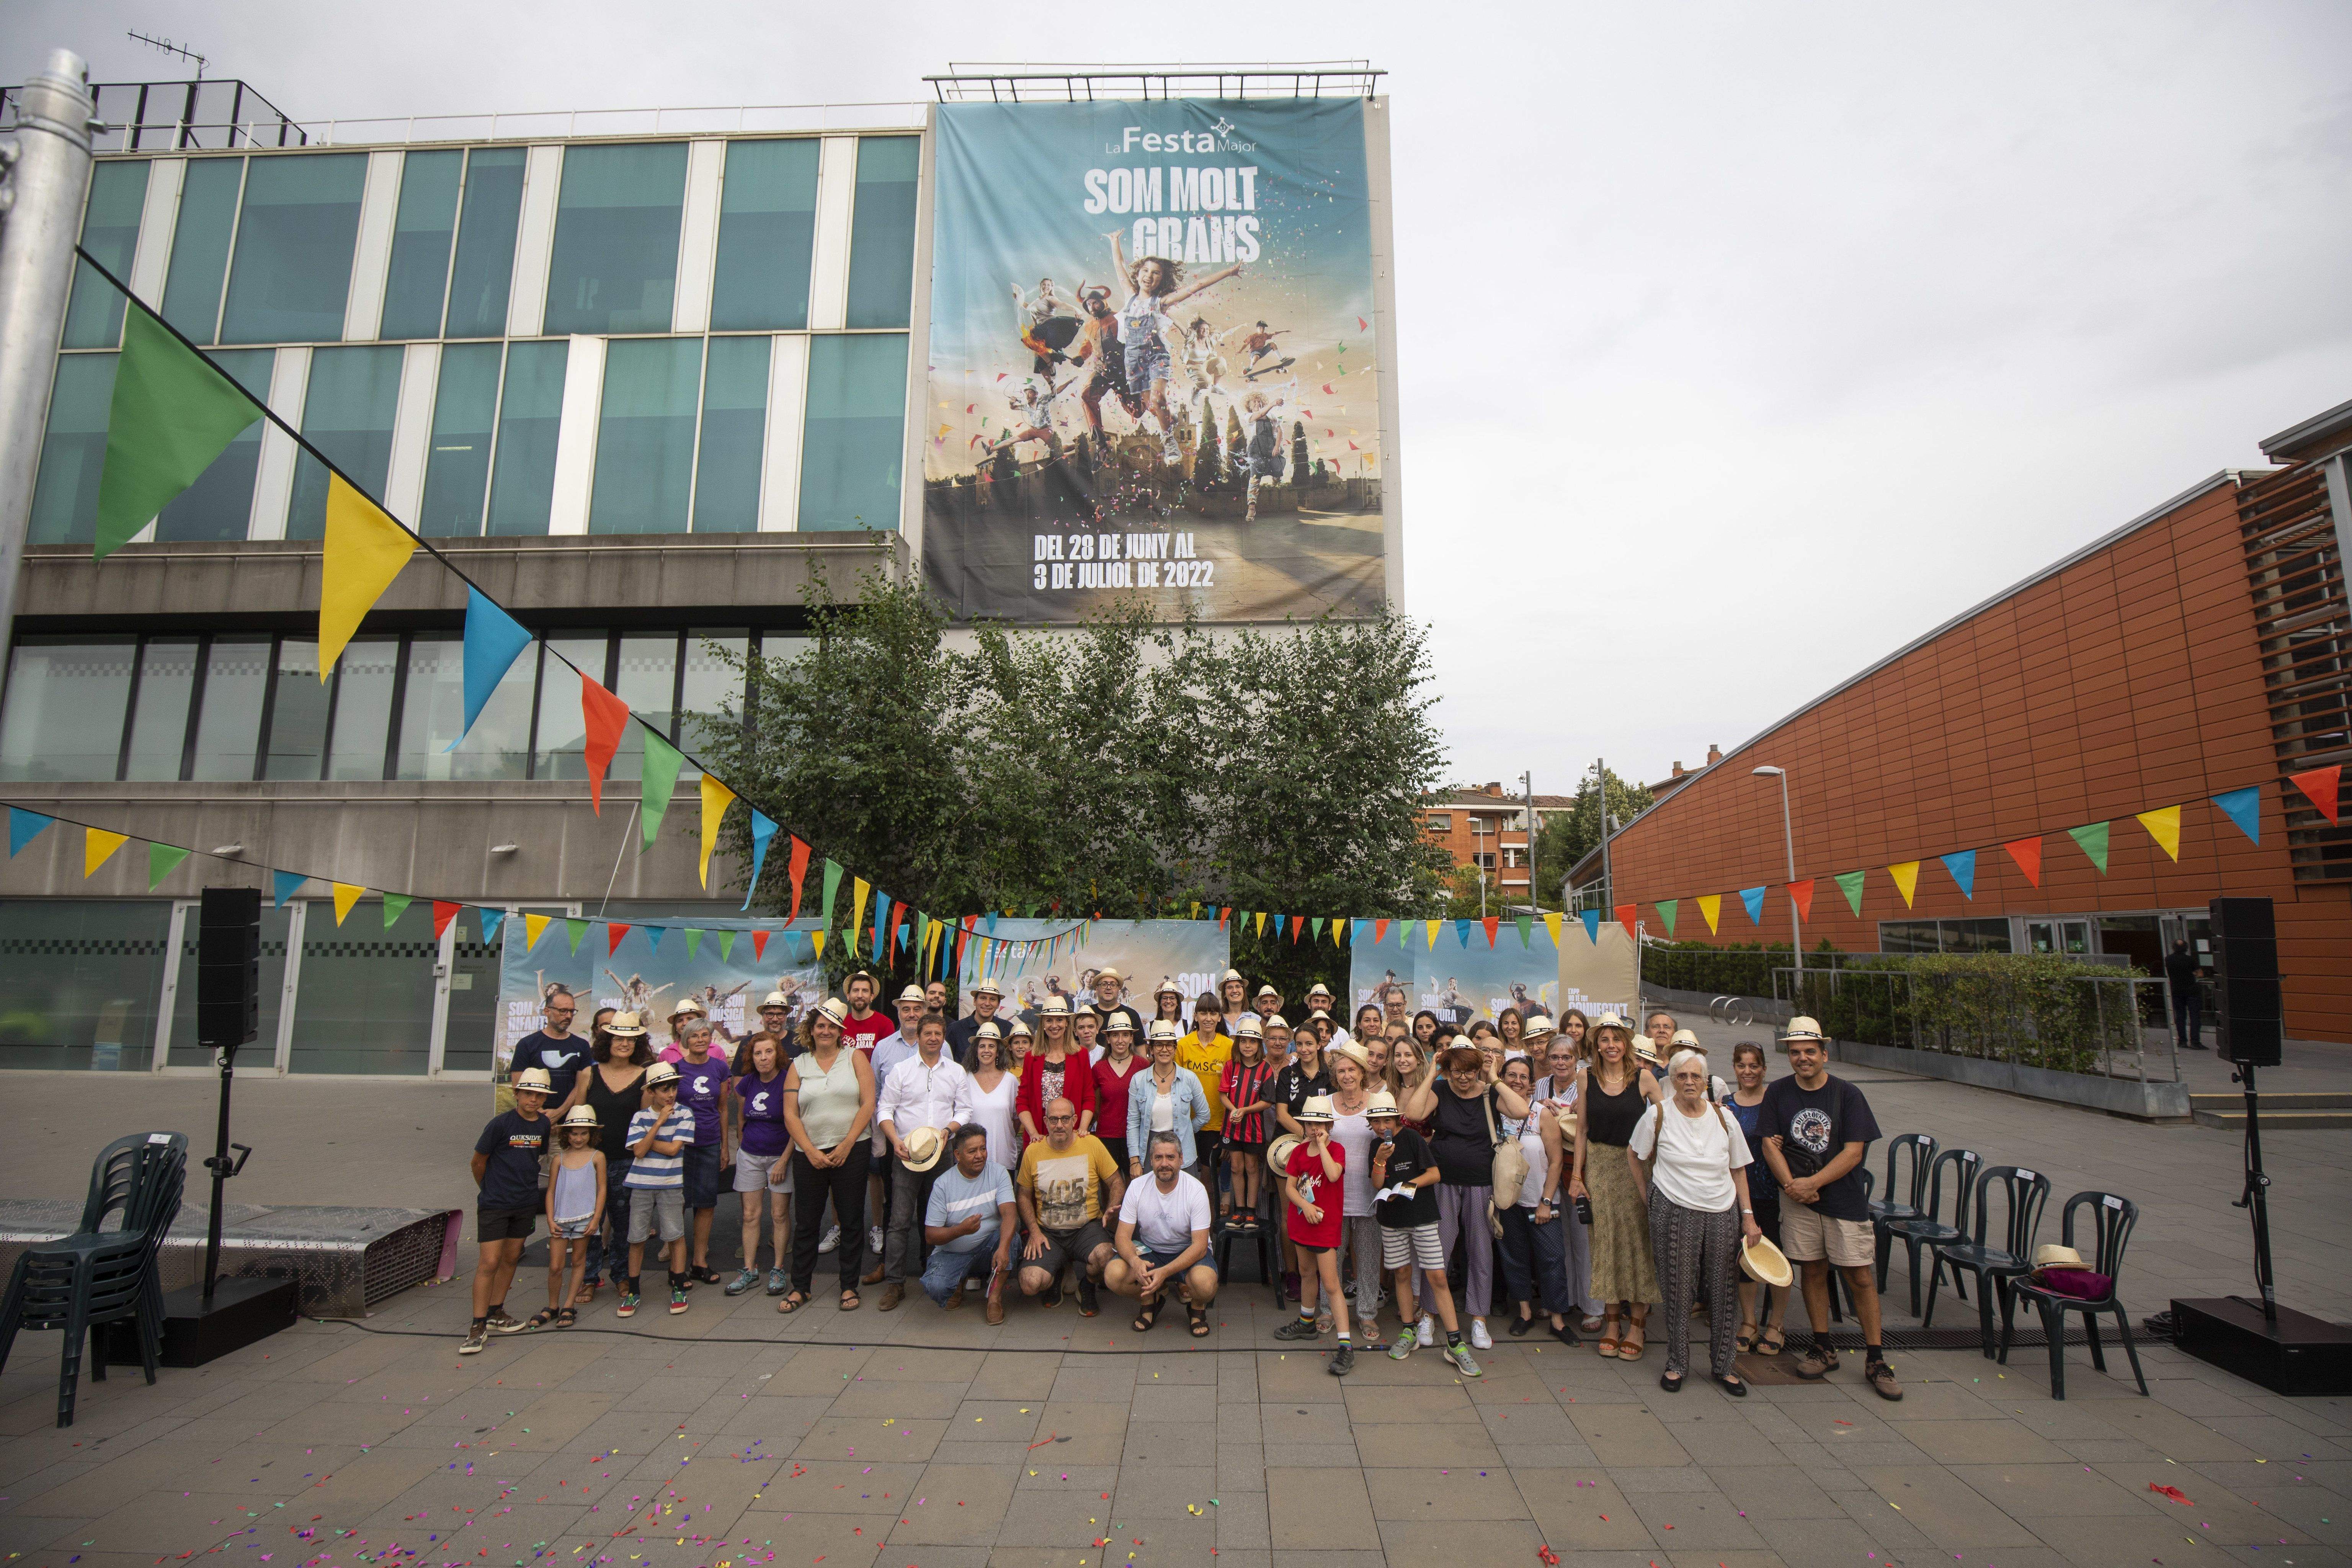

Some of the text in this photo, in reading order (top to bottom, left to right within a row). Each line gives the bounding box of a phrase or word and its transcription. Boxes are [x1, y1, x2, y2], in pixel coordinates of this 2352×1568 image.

[1106, 126, 1256, 153] La Festa Major
[1084, 166, 1258, 214] SOM MOLT
[1132, 215, 1261, 263] GRANS
[1034, 533, 1196, 560] DEL 28 DE JUNY AL
[1034, 561, 1214, 590] 3 DE JULIOL DE 2022
[1178, 973, 1215, 999] SOM
[725, 994, 746, 1008] SOM
[1421, 993, 1439, 1007] SOM
[1491, 998, 1510, 1012] SOM
[508, 1001, 533, 1016] SOM
[708, 1005, 745, 1022] MÚSICA
[855, 1041, 874, 1049] ARRAN,
[856, 1033, 875, 1041] SEGUEU
[1232, 1076, 1238, 1088] 5
[1795, 1111, 1830, 1127] DUBROVNIK
